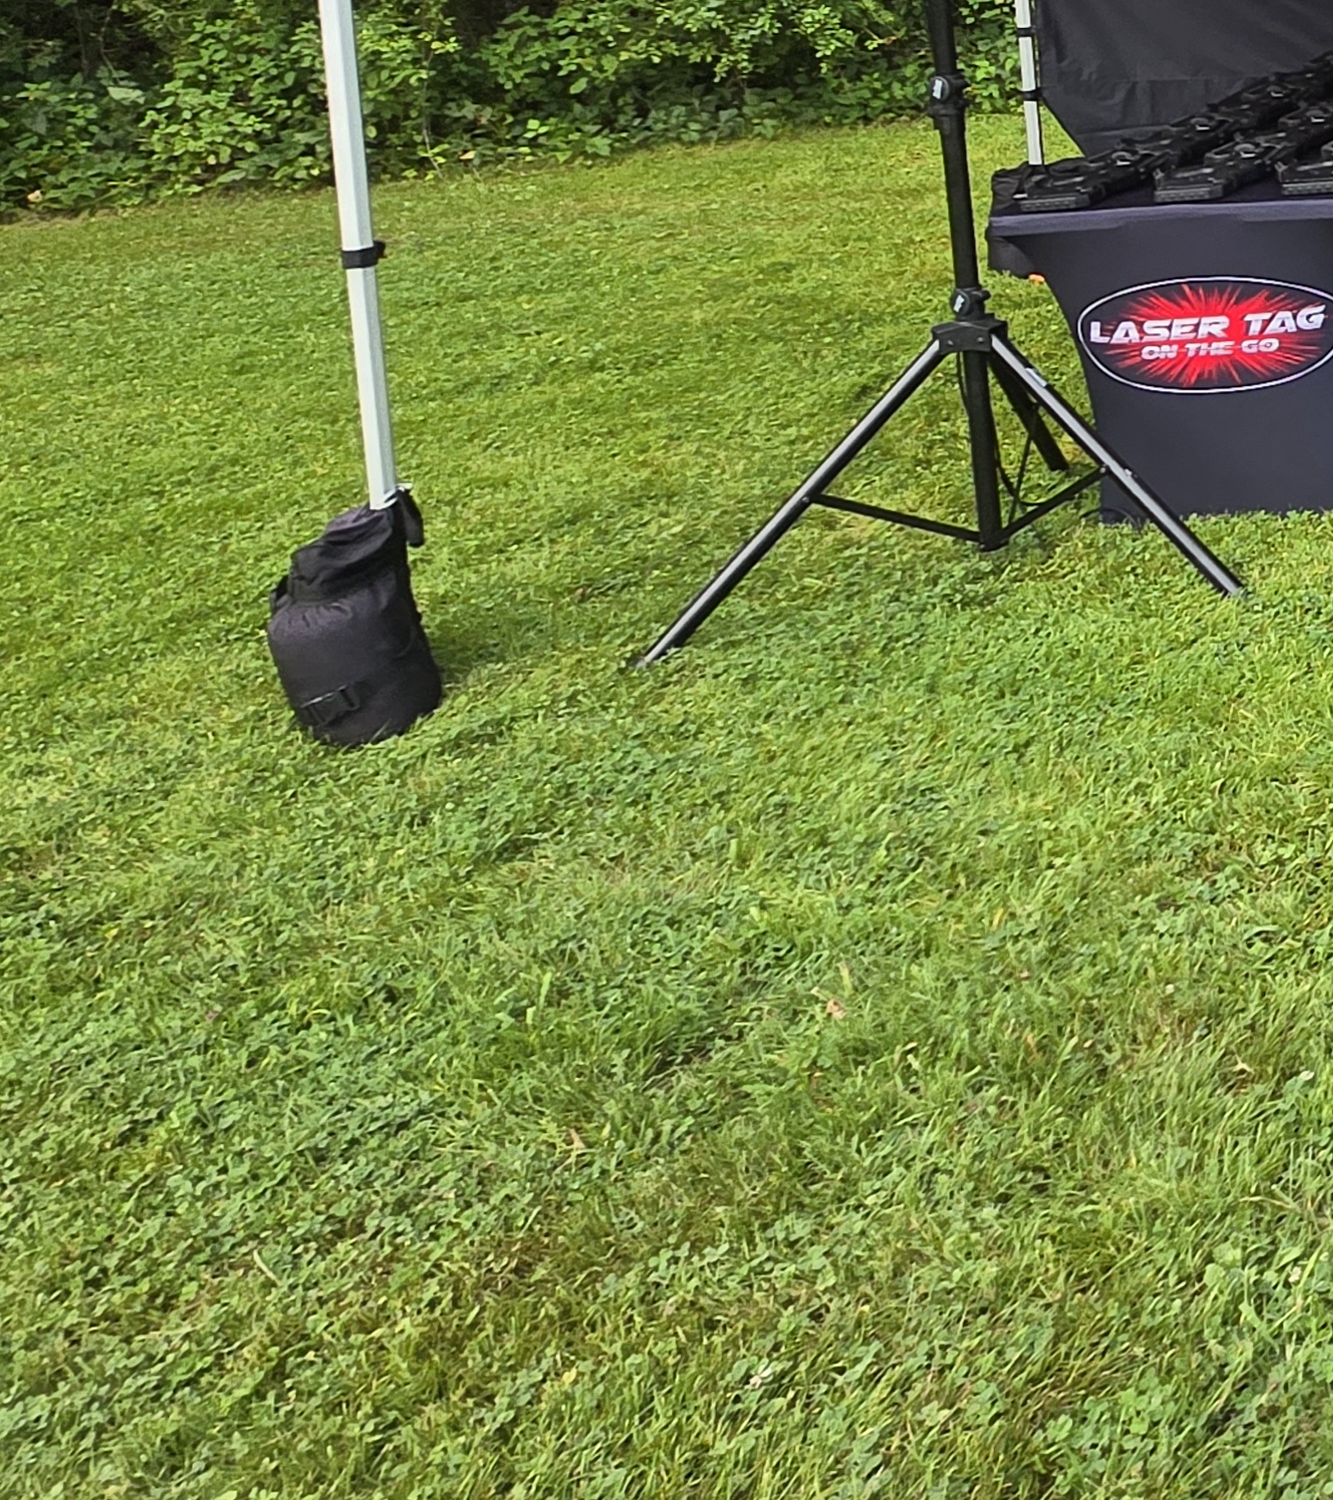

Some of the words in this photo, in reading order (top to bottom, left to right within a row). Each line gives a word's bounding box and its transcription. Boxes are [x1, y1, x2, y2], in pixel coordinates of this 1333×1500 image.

[1090, 314, 1230, 345] LASER
[1244, 304, 1327, 337] TAG
[1141, 343, 1177, 361] ON
[1184, 340, 1235, 357] THE
[1242, 337, 1280, 354] GO
